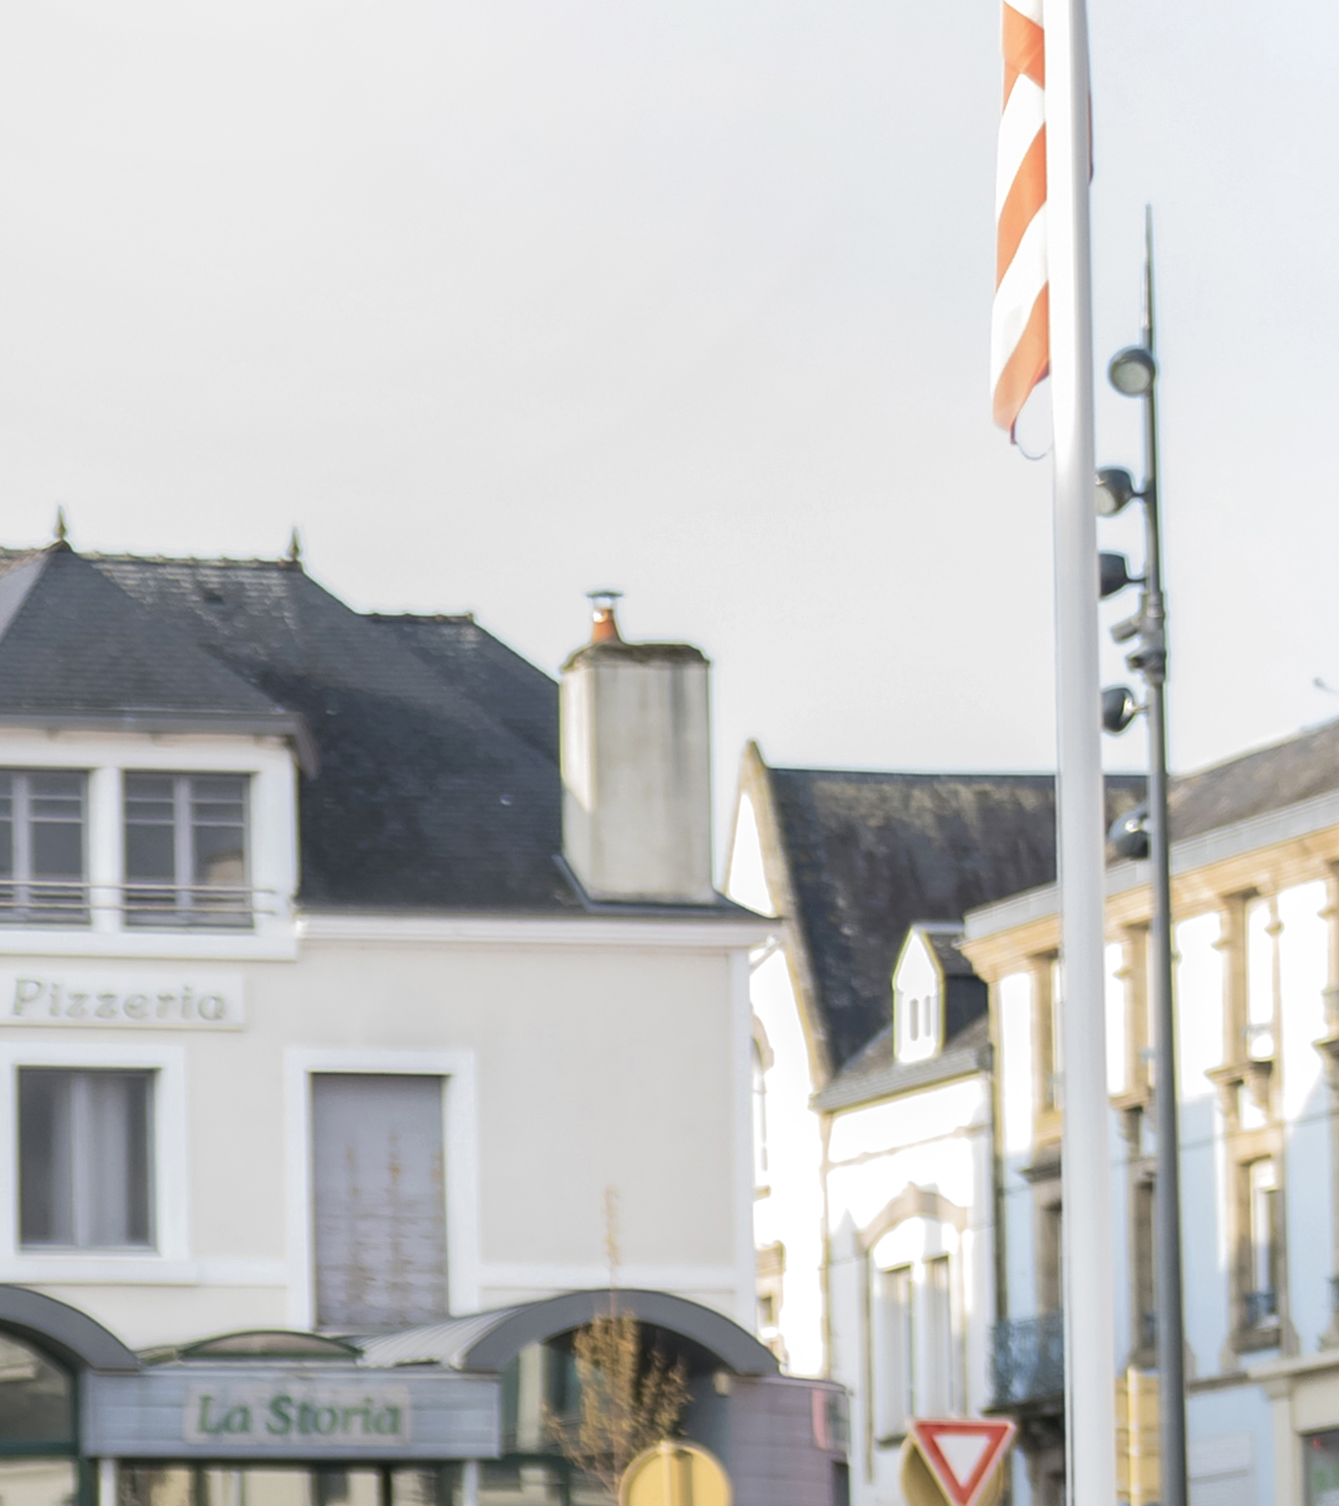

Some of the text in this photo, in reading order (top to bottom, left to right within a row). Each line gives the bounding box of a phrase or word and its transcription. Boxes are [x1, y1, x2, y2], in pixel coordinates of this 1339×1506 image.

[12, 978, 225, 1020] Pizzeria
[197, 1394, 402, 1435] La Storia
